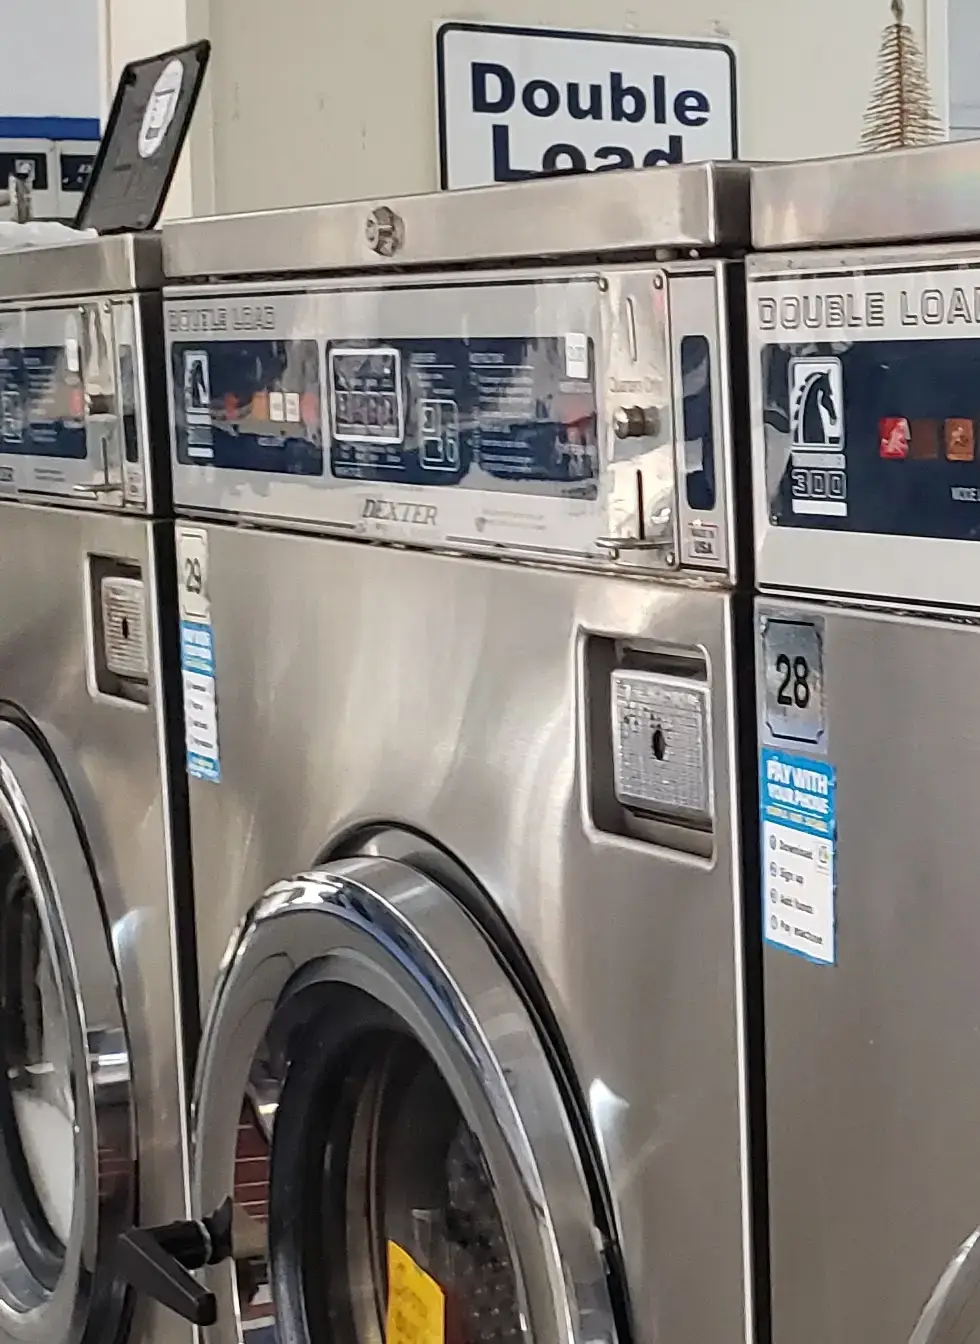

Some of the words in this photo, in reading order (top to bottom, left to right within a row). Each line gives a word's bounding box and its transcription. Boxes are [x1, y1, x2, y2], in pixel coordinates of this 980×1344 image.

[471, 62, 711, 127] Double
[758, 292, 885, 330] DOUBLE
[791, 469, 847, 500] 300
[361, 498, 438, 525] DEXTER
[185, 557, 202, 595] 29
[776, 653, 809, 709] 28
[766, 759, 792, 784] PAY
[792, 765, 829, 796] WITH
